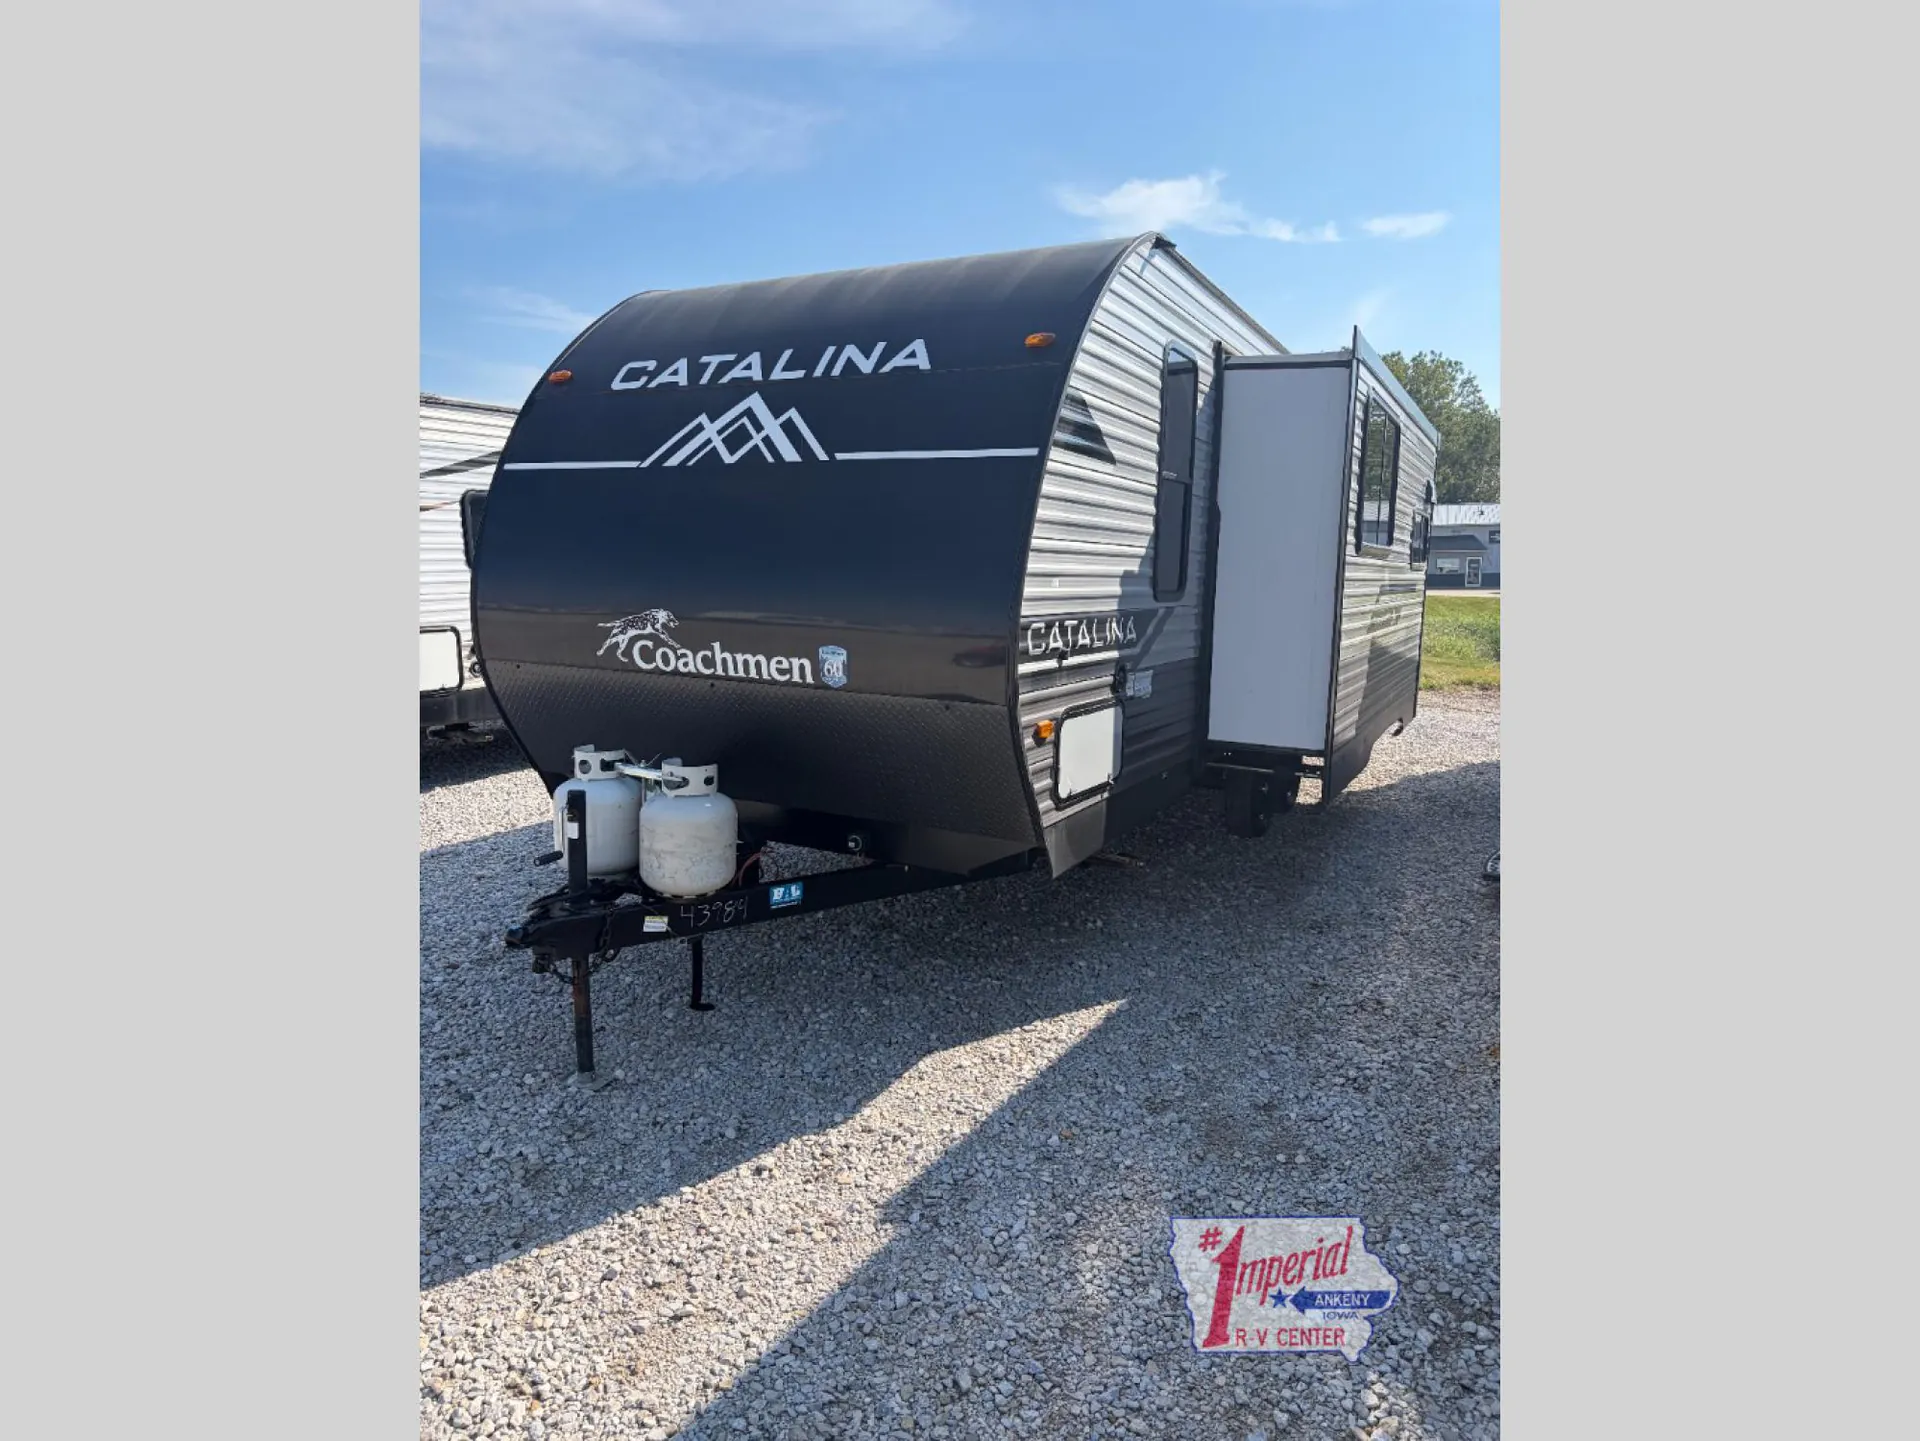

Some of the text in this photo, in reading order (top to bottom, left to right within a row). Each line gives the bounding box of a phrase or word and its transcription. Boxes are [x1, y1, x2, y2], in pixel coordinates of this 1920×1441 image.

[611, 338, 931, 390] CATALINA
[1027, 616, 1136, 655] CATALINA
[632, 641, 814, 684] Coachmen
